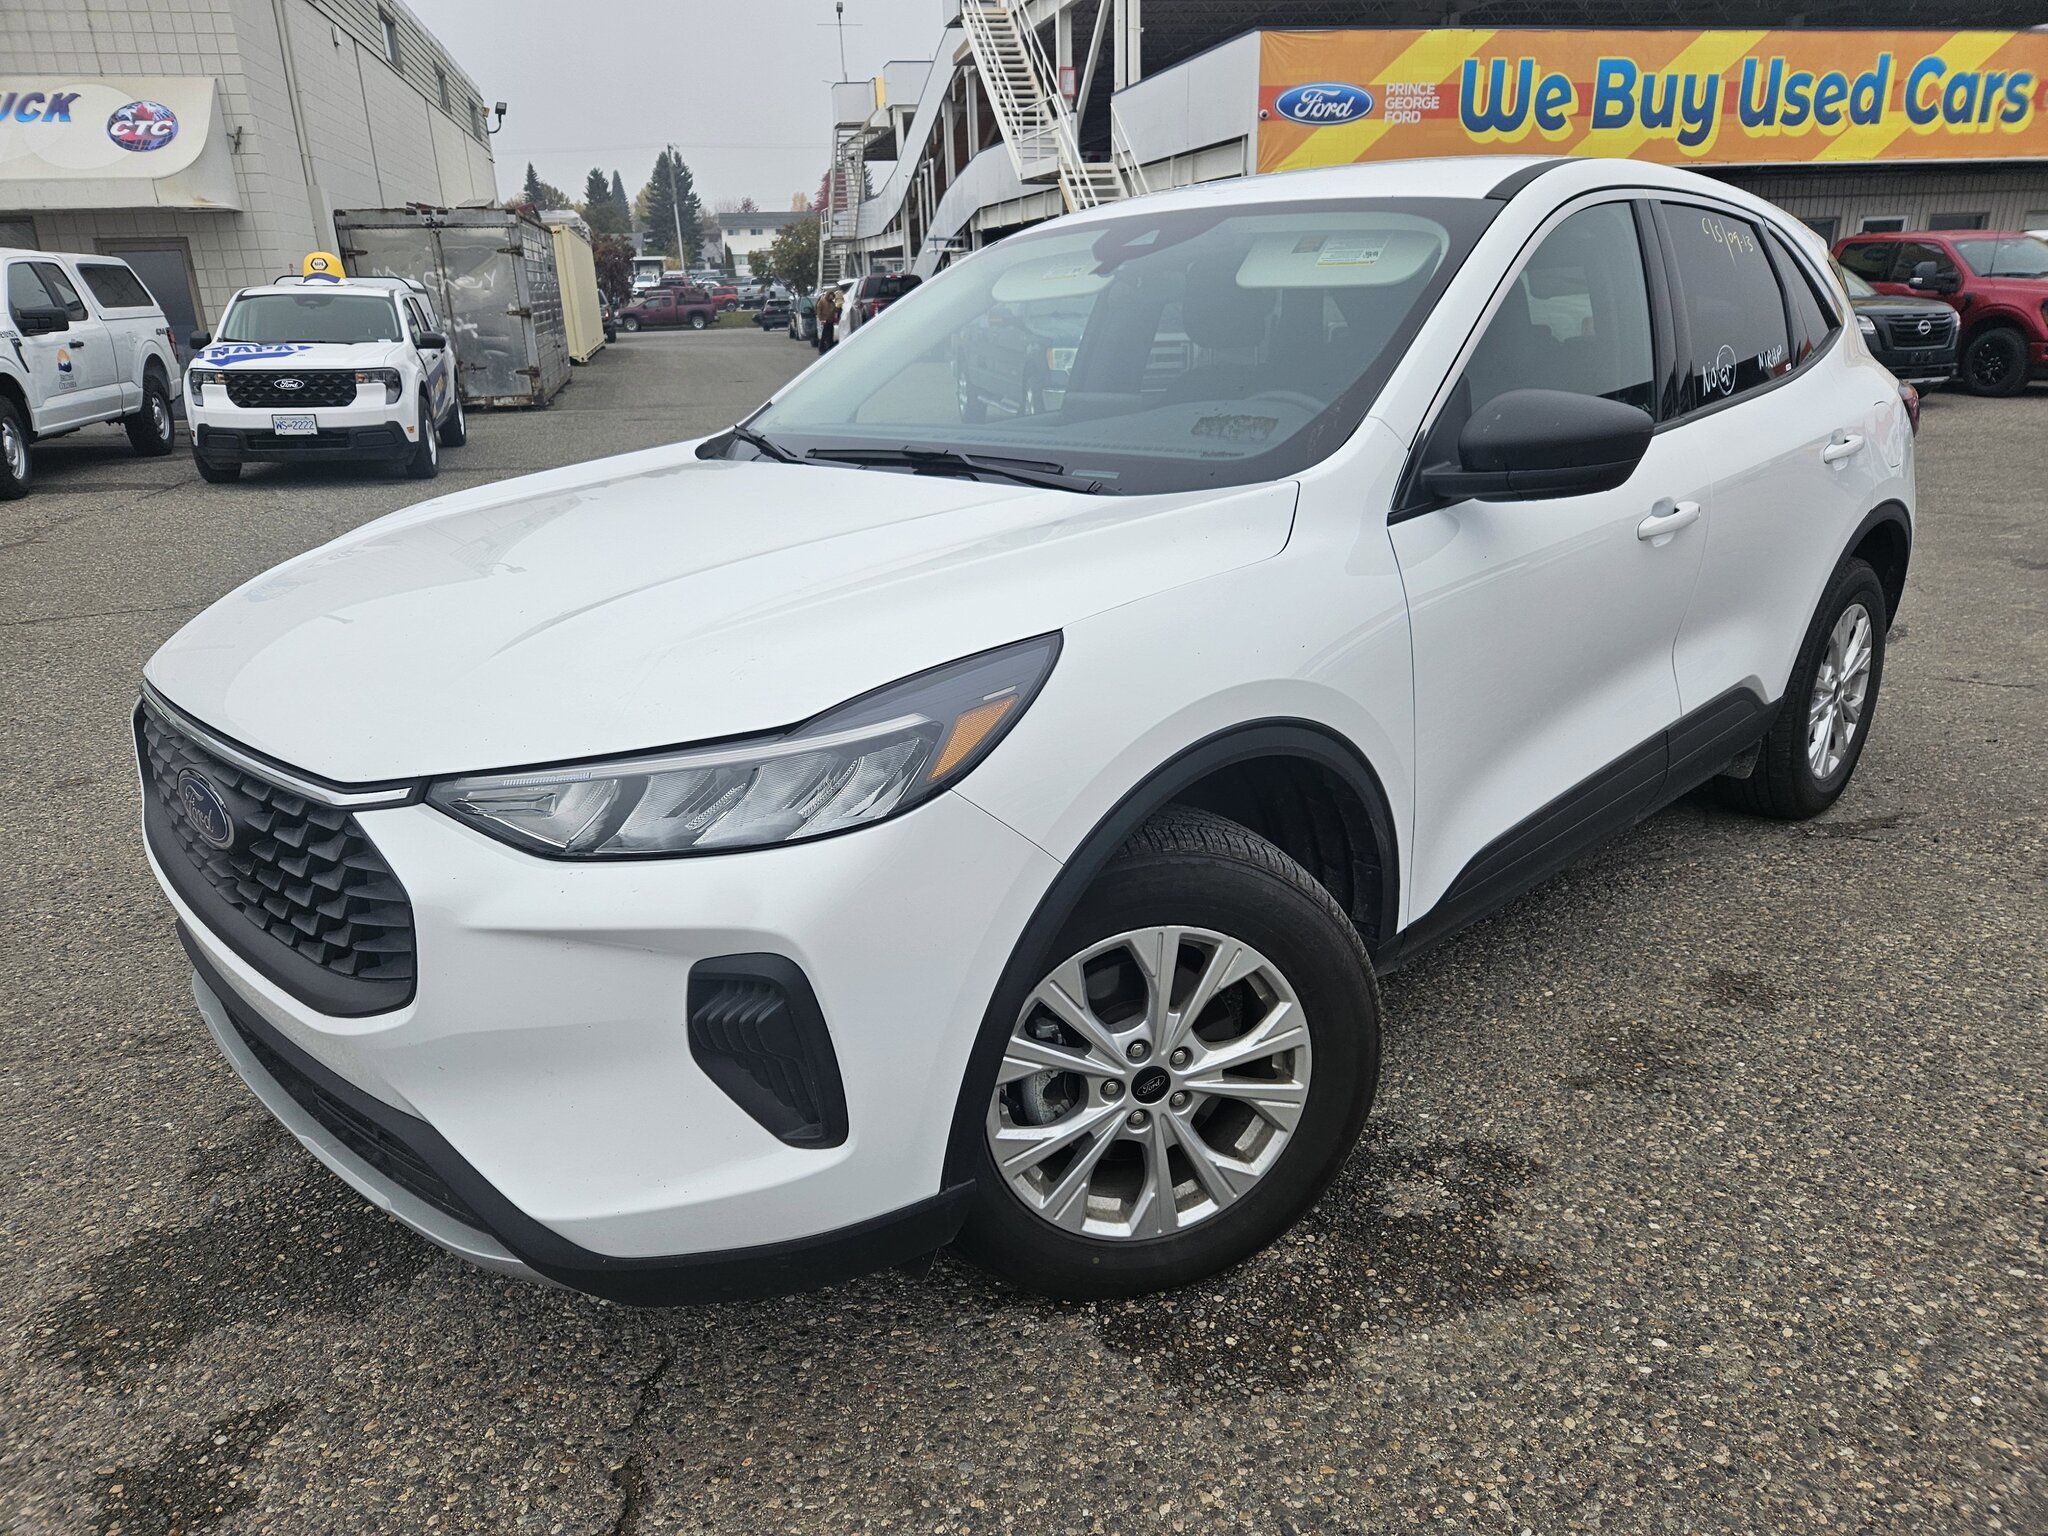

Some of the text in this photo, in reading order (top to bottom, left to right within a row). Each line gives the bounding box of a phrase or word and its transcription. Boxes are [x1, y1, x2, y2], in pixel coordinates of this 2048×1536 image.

[1385, 82, 1436, 96] PRINCE
[1293, 87, 1359, 119] Ford
[1384, 96, 1440, 110] GEORGE
[1459, 53, 2034, 148] We Buy Used Cars
[1383, 110, 1421, 124] FORD
[109, 120, 173, 136] CTC
[184, 783, 215, 833] Ford
